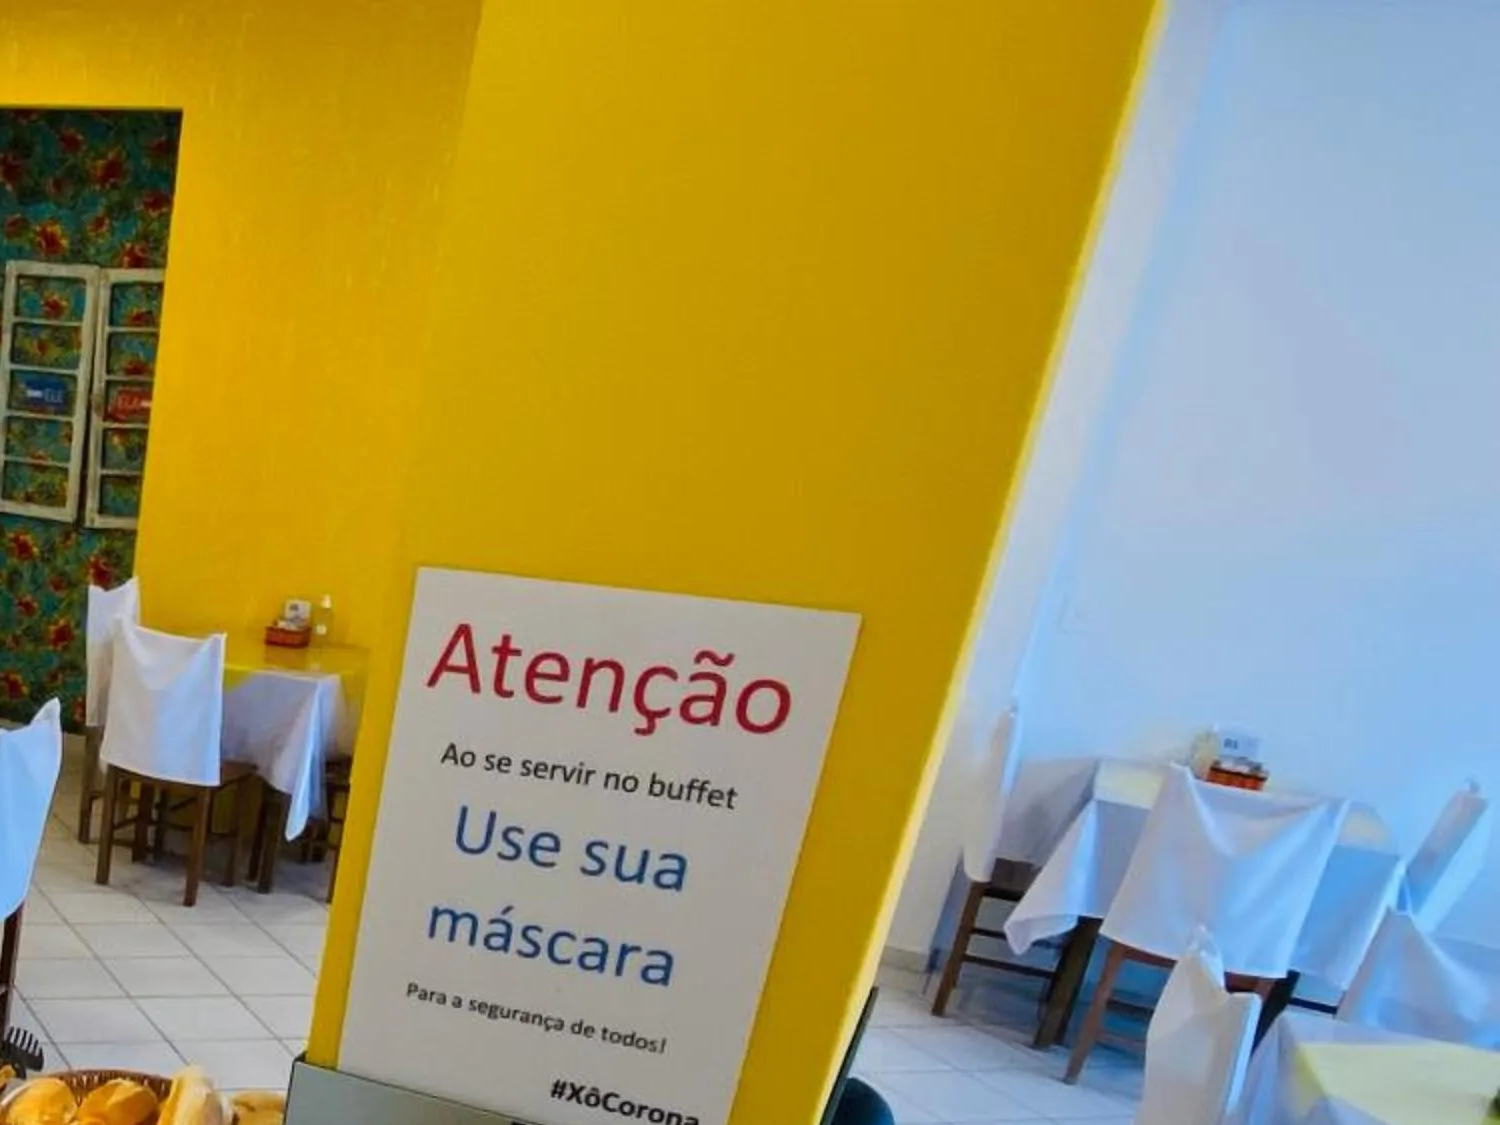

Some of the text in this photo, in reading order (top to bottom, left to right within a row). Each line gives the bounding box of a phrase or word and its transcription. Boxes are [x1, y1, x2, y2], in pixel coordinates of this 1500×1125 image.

[426, 621, 793, 738] Atenção
[440, 742, 739, 811] Ao se servir no buffet
[454, 805, 689, 893] Use sua
[426, 903, 676, 989] máscara
[405, 982, 668, 1056] Para a segurança de todos!
